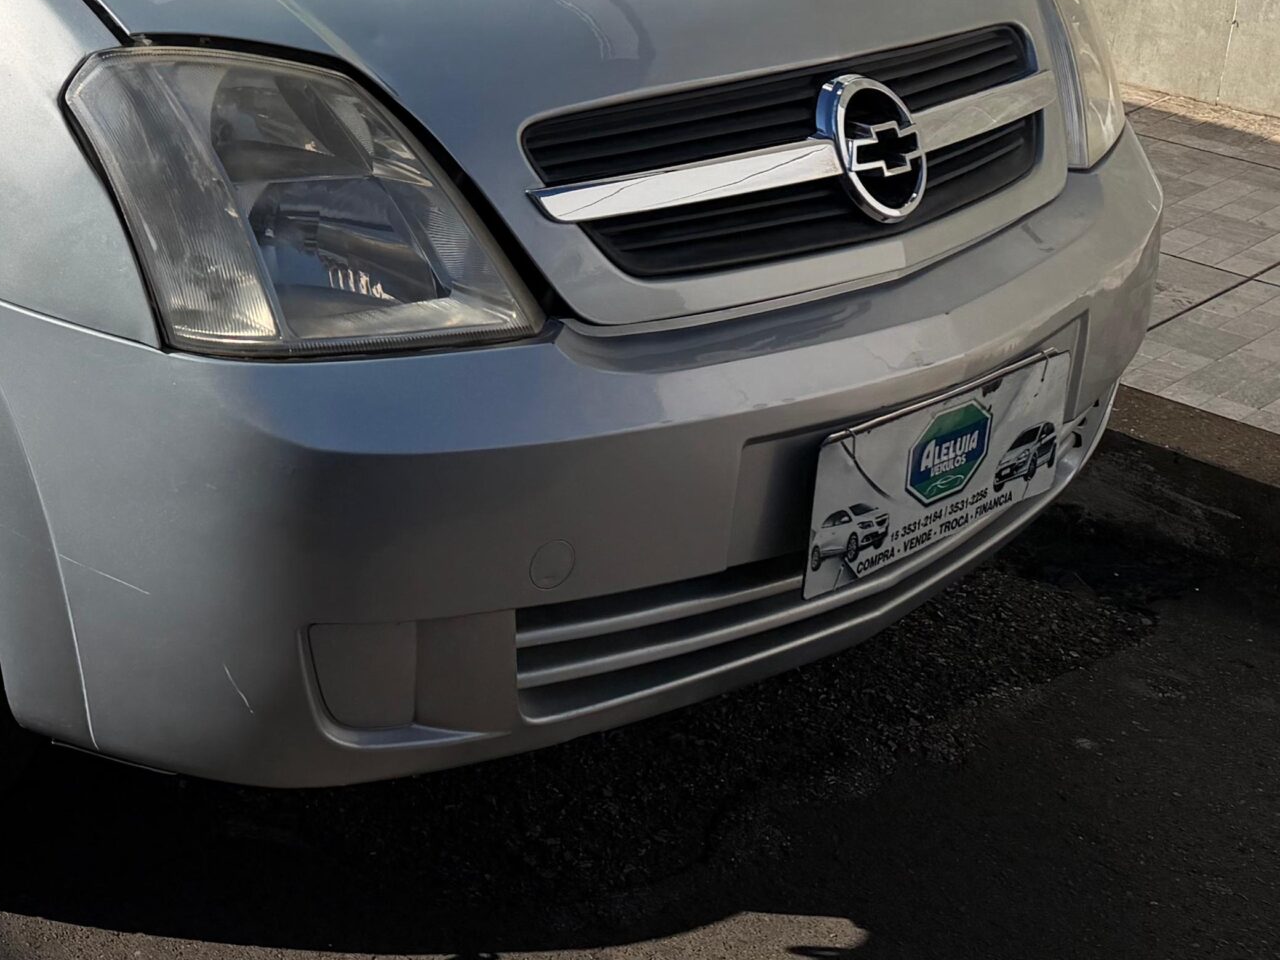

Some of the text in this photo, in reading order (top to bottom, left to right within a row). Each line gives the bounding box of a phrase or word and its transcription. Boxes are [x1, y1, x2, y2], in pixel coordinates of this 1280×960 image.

[920, 430, 979, 472] ALELUIA
[856, 491, 1013, 574] COMPRA VENDE TROCA FINANCIA
